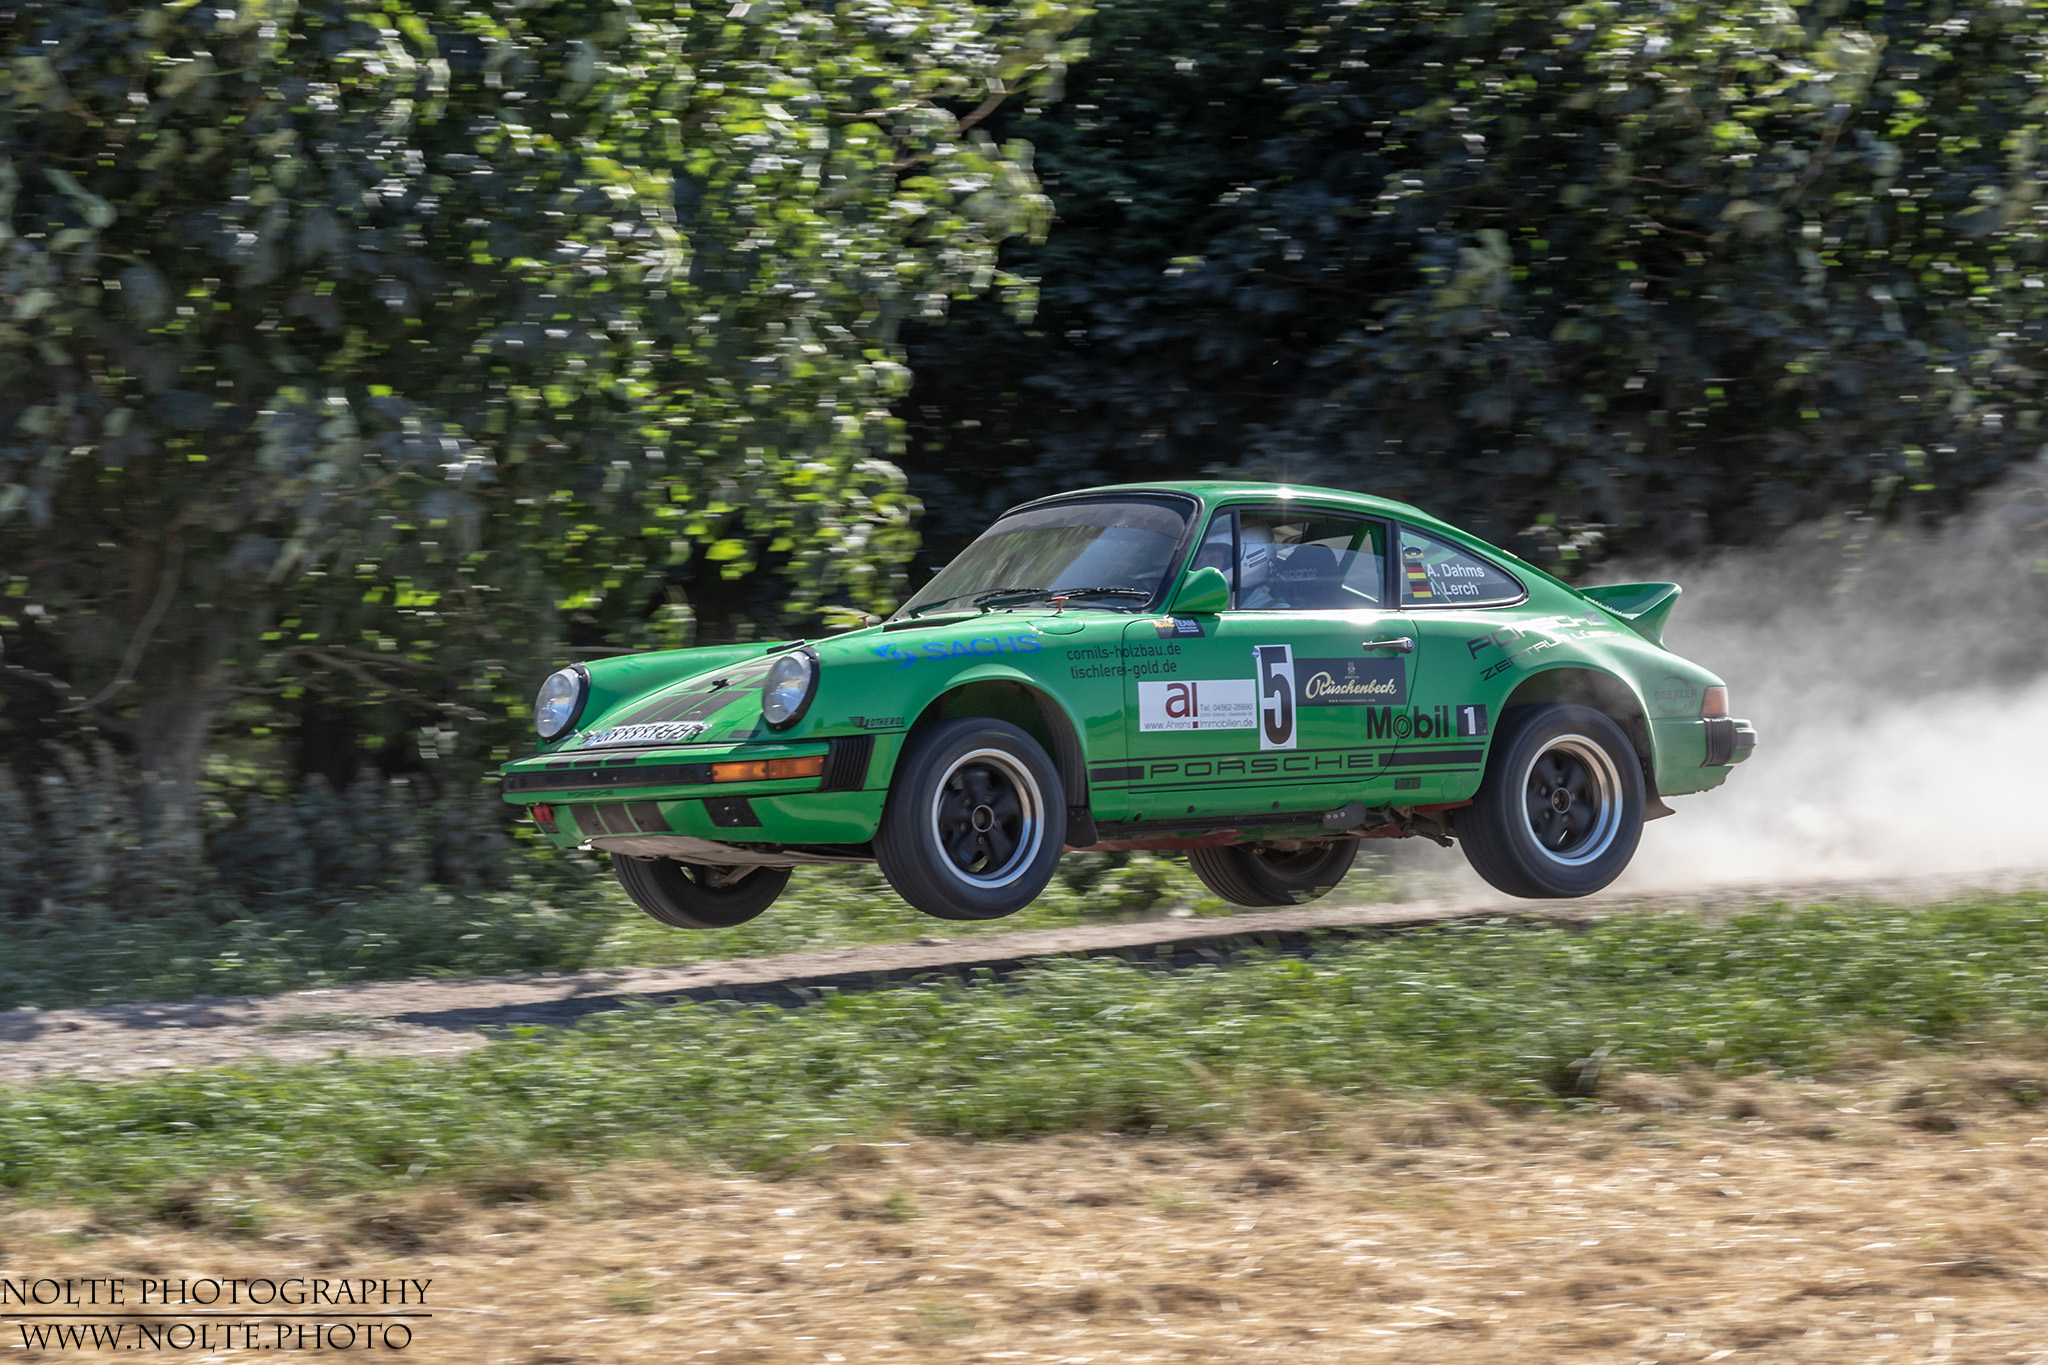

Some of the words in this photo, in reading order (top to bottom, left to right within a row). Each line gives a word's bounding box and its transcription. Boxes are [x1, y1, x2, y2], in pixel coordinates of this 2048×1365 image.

[1426, 563, 1440, 578] A.
[1441, 563, 1485, 578] Dahms
[1441, 581, 1480, 596] Lerch
[922, 633, 1044, 661] SACHS
[1066, 642, 1182, 660] cornils-holzbau.de
[1070, 659, 1177, 679] tischlerei-gold.de
[1260, 646, 1293, 744] 5
[1305, 671, 1397, 699] Rüschenbeck
[1654, 687, 1698, 702] DREXLER
[1366, 705, 1450, 739] Mobil
[1463, 706, 1477, 735] 1
[1149, 753, 1374, 780] PORSCHE
